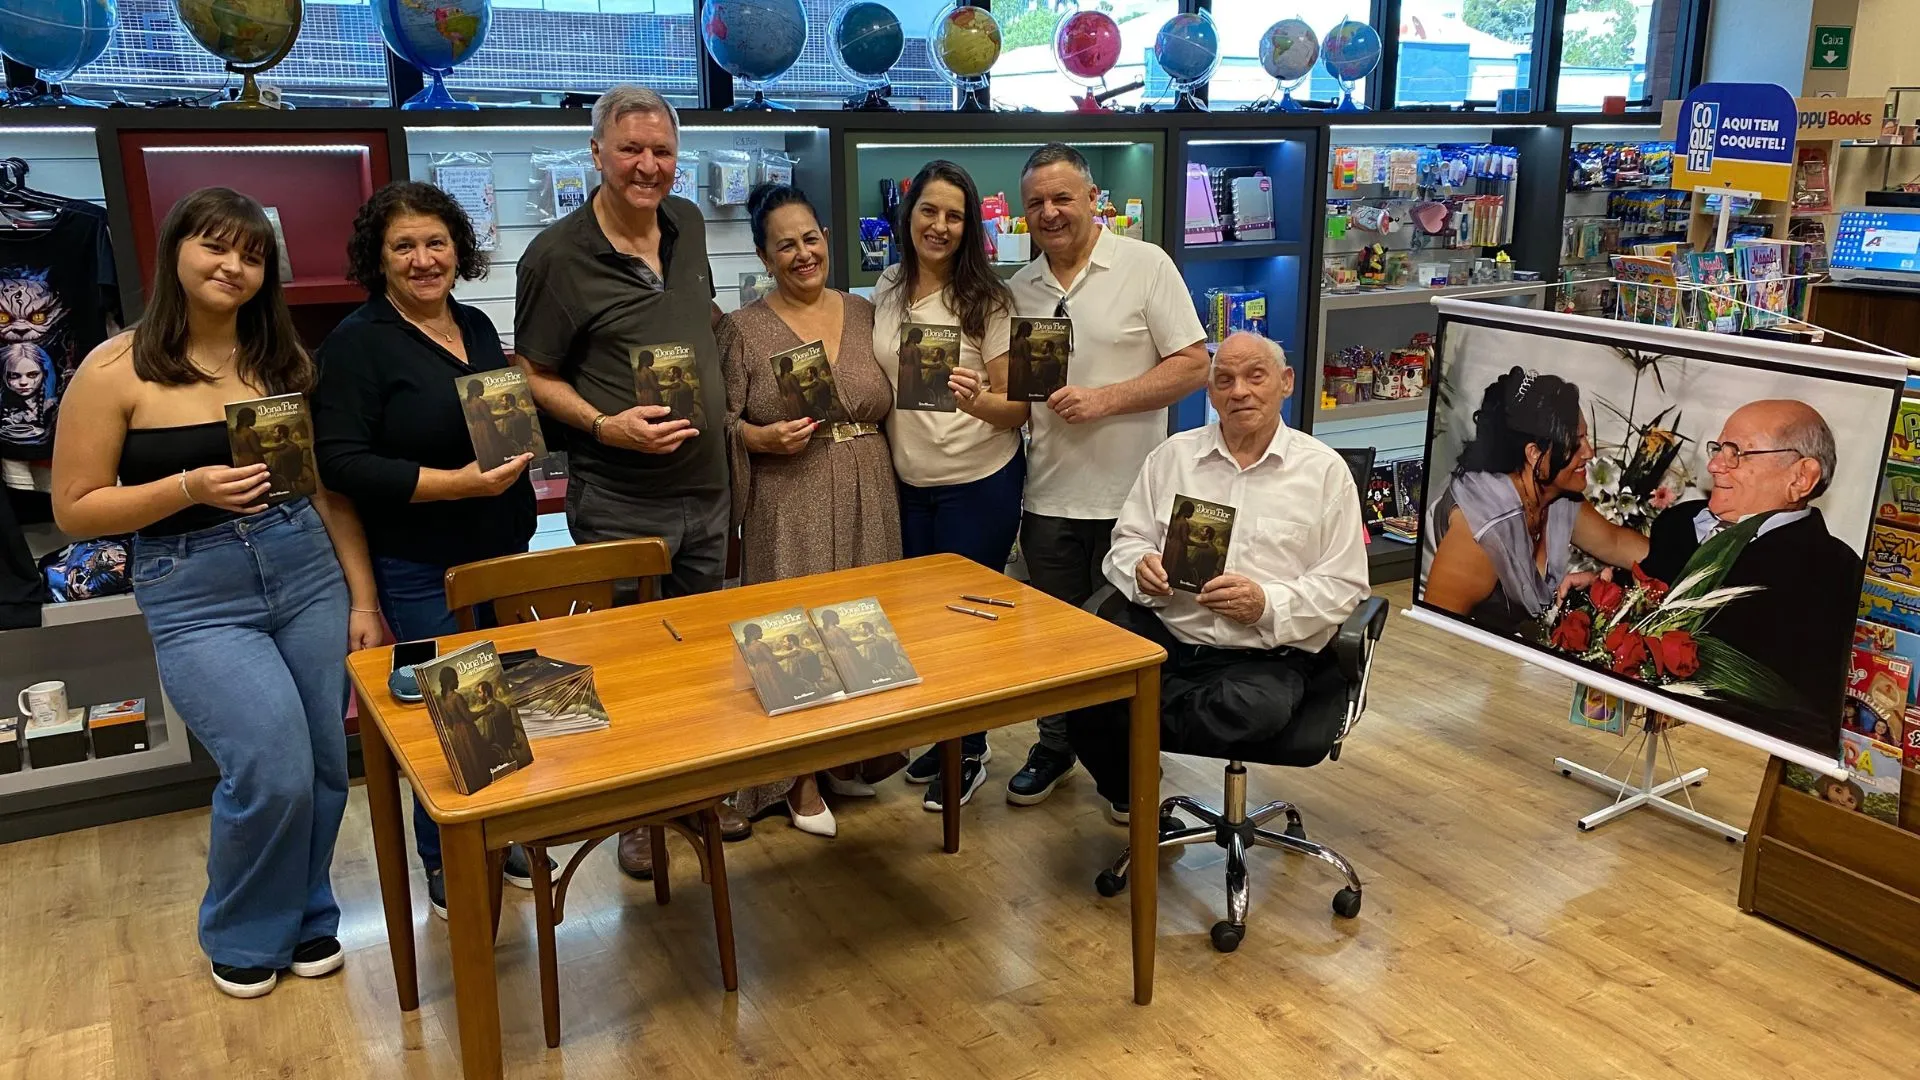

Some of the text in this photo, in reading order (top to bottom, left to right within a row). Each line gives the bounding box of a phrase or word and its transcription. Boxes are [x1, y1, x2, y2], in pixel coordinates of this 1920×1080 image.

[1821, 33, 1845, 45] Caixa
[1693, 103, 1712, 129] CO
[1721, 117, 1779, 132] AQUI TEM
[1689, 128, 1715, 152] QUE
[1720, 134, 1786, 151] COQUETEL!
[1688, 149, 1712, 172] TEL
[924, 328, 958, 338] Dona Flor
[1034, 321, 1067, 331] Dona Flor
[654, 348, 675, 358] Dona
[674, 345, 690, 355] Flor
[484, 375, 505, 386] Dona
[505, 371, 522, 381] Flor
[257, 404, 281, 417] Dona
[281, 401, 299, 412] Flor
[1196, 503, 1216, 515] Dona
[1215, 508, 1231, 519] Flor
[456, 659, 480, 674] Dona
[477, 652, 494, 664] Flor
